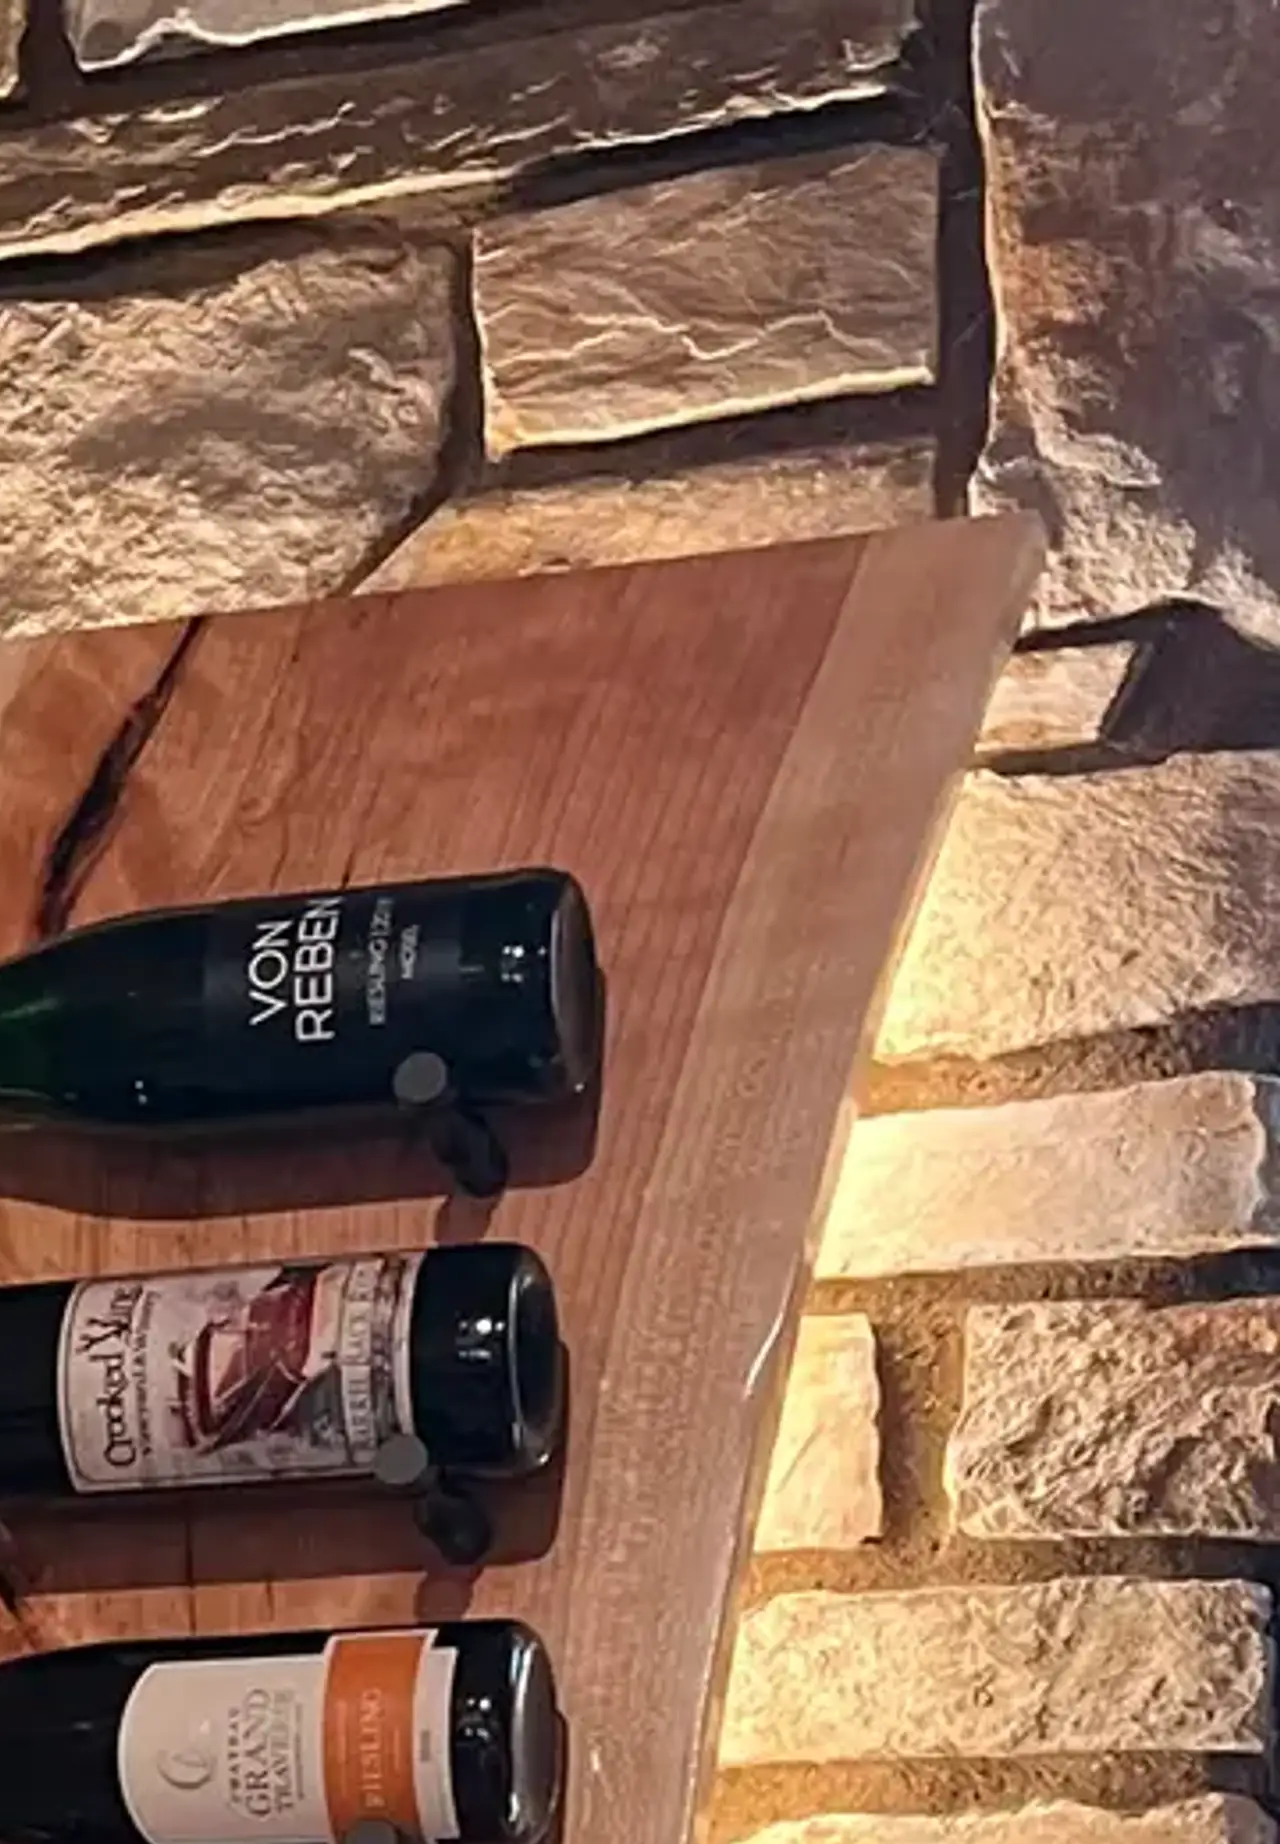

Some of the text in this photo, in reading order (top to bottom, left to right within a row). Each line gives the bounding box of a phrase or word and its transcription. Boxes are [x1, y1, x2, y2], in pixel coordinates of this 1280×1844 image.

[247, 919, 293, 1026] VON
[295, 895, 343, 1042] REBEN
[367, 940, 388, 1025] RIESLING
[74, 1285, 142, 1467] Crooked Vine
[241, 1688, 271, 1817] GRAND
[358, 1687, 385, 1808] RIESLING
